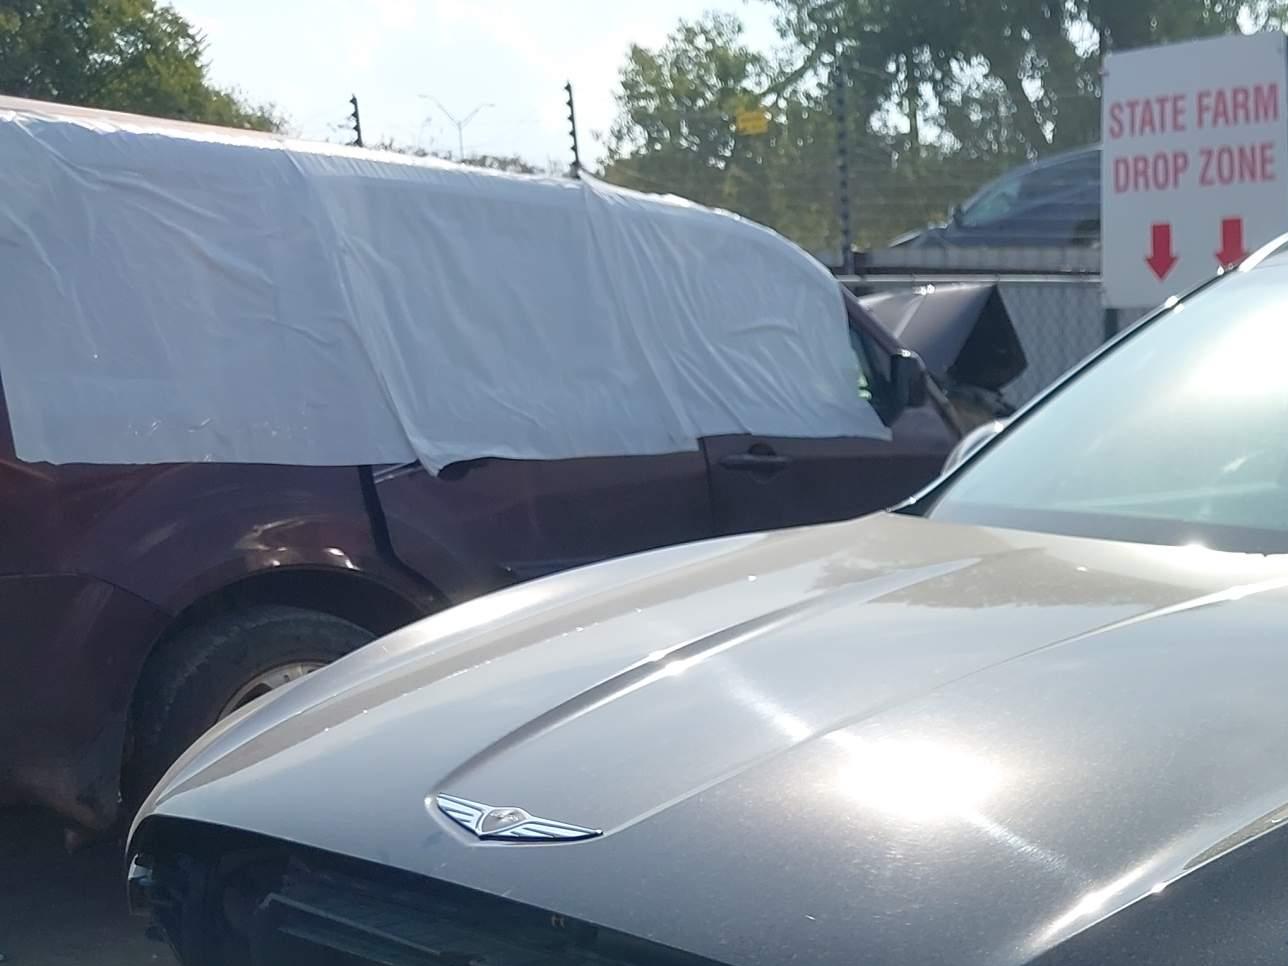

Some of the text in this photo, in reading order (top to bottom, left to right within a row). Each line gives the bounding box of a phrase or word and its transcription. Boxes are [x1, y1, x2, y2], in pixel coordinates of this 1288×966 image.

[1109, 83, 1280, 139] STATE FARM
[1114, 143, 1275, 194] DROP ZONE
